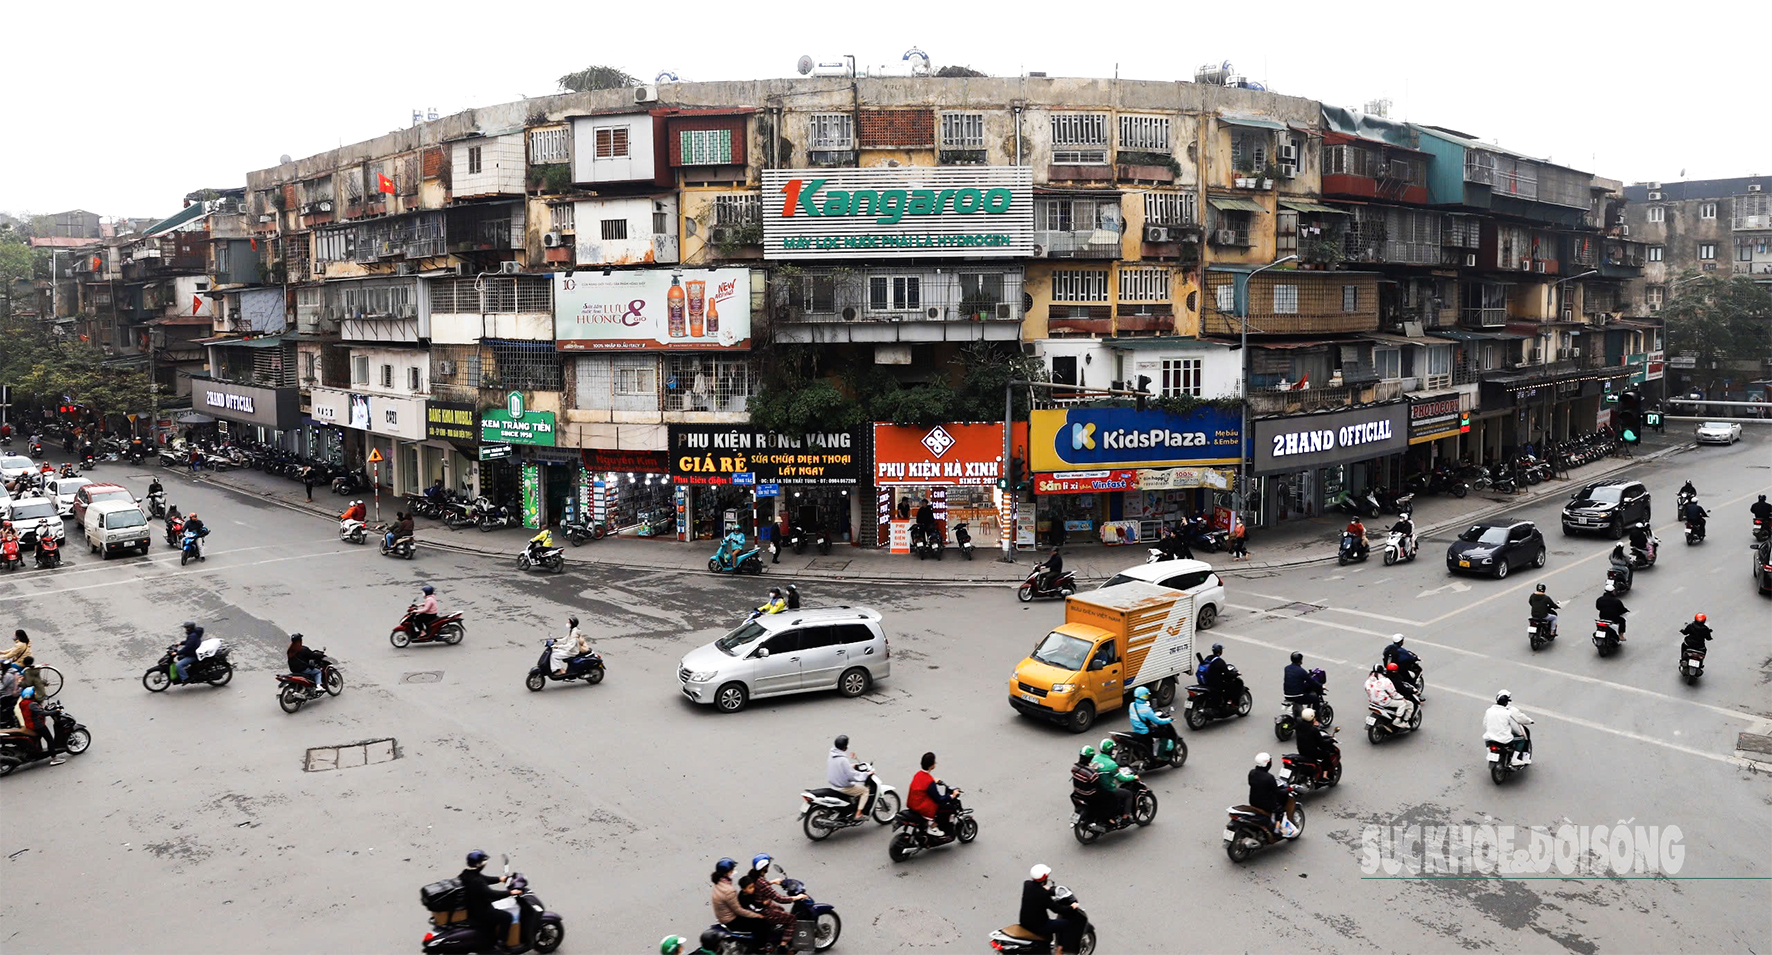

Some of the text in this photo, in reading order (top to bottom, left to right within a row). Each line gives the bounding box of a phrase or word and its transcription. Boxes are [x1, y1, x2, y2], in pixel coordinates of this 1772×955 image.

[783, 234, 812, 249] MÁY
[815, 236, 840, 250] LỌC
[844, 233, 879, 248] NƯỚC
[937, 233, 1010, 247] HYDROGEN
[718, 278, 737, 293] NEW
[621, 299, 646, 327] 8
[226, 393, 254, 413] OFFICIAL
[1411, 398, 1459, 419] PHOTOCOPY
[481, 418, 552, 432] KEM TRÀNG TIỀN
[500, 430, 519, 438] SINCE
[678, 432, 709, 451] PHỤ
[714, 430, 751, 452] KIỆN
[1103, 428, 1206, 449] KidsPlaza
[1272, 429, 1336, 458] 2HAND
[1338, 419, 1392, 448] OFFICIAL
[679, 452, 748, 472] GIÁ RẺ
[750, 453, 851, 465] SỬA CHỮA ĐIỆN THOẠI
[778, 464, 824, 476] LẤY NGAY
[878, 458, 999, 481] PHỤ KIỆN HÀ XINH
[1039, 480, 1062, 492] Săn
[1070, 481, 1078, 490] xì
[1092, 479, 1126, 490] Vinfast
[1108, 614, 1121, 622] NAM
